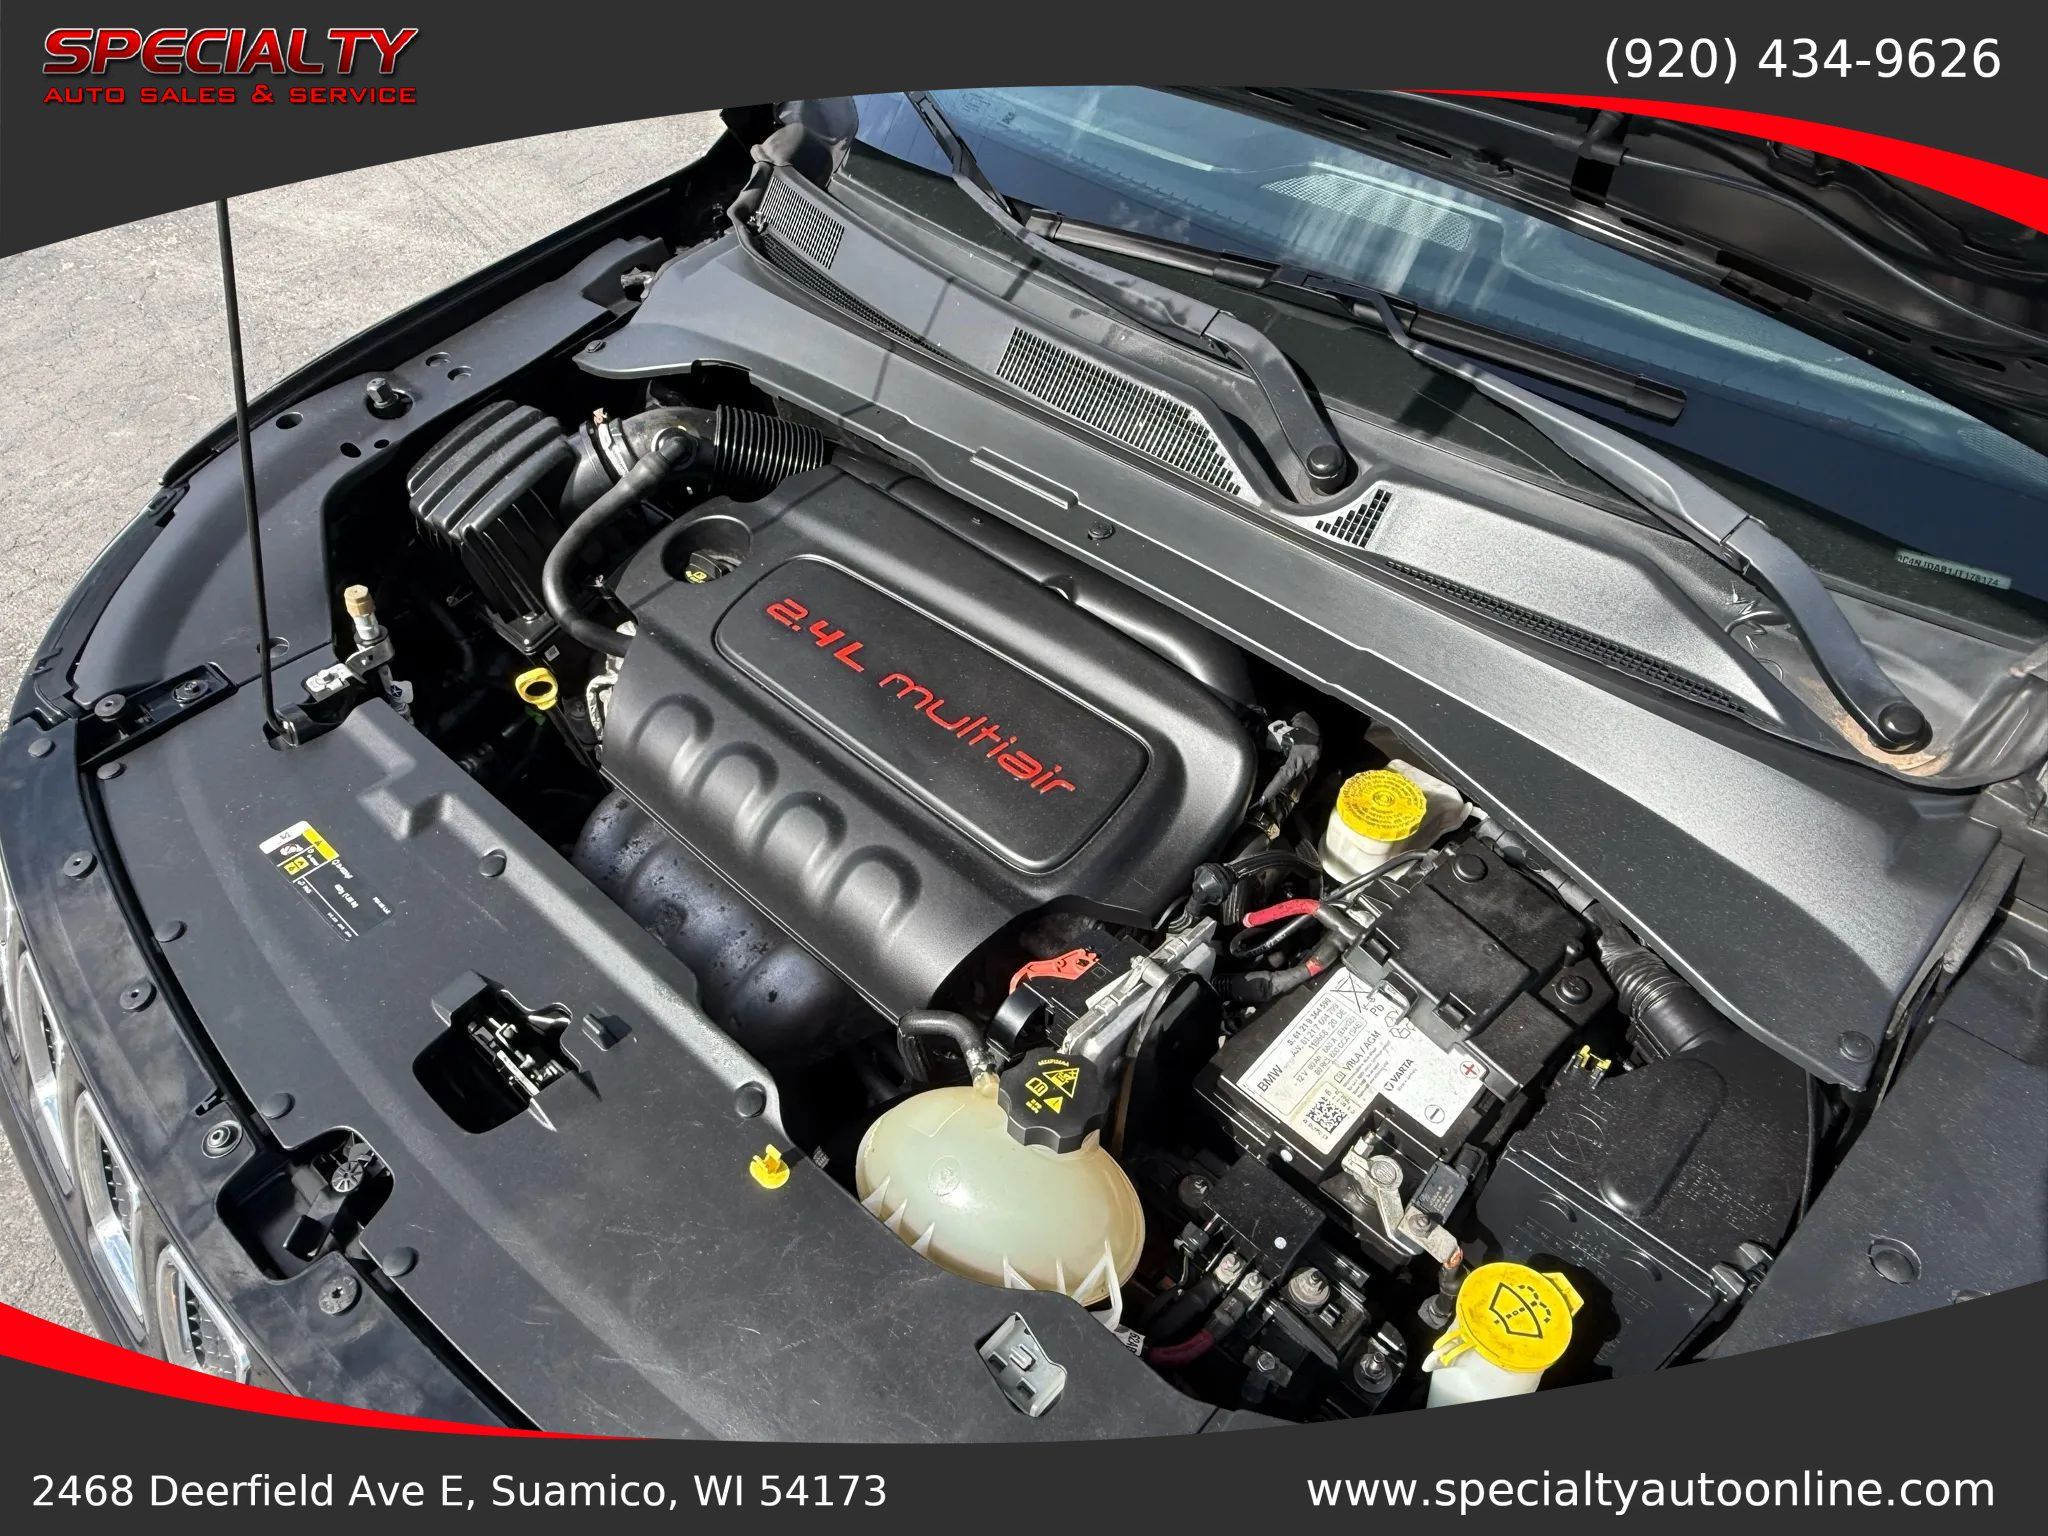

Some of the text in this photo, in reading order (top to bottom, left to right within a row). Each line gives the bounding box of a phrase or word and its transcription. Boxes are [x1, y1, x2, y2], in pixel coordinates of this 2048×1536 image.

[879, 672, 1076, 794] multiair
[1369, 1004, 1385, 1017] Pb
[1343, 1049, 1364, 1073] VRLA
[1361, 1029, 1381, 1050] AGM
[1257, 1064, 1283, 1093] BMW
[1390, 1057, 1414, 1085] VARTA
